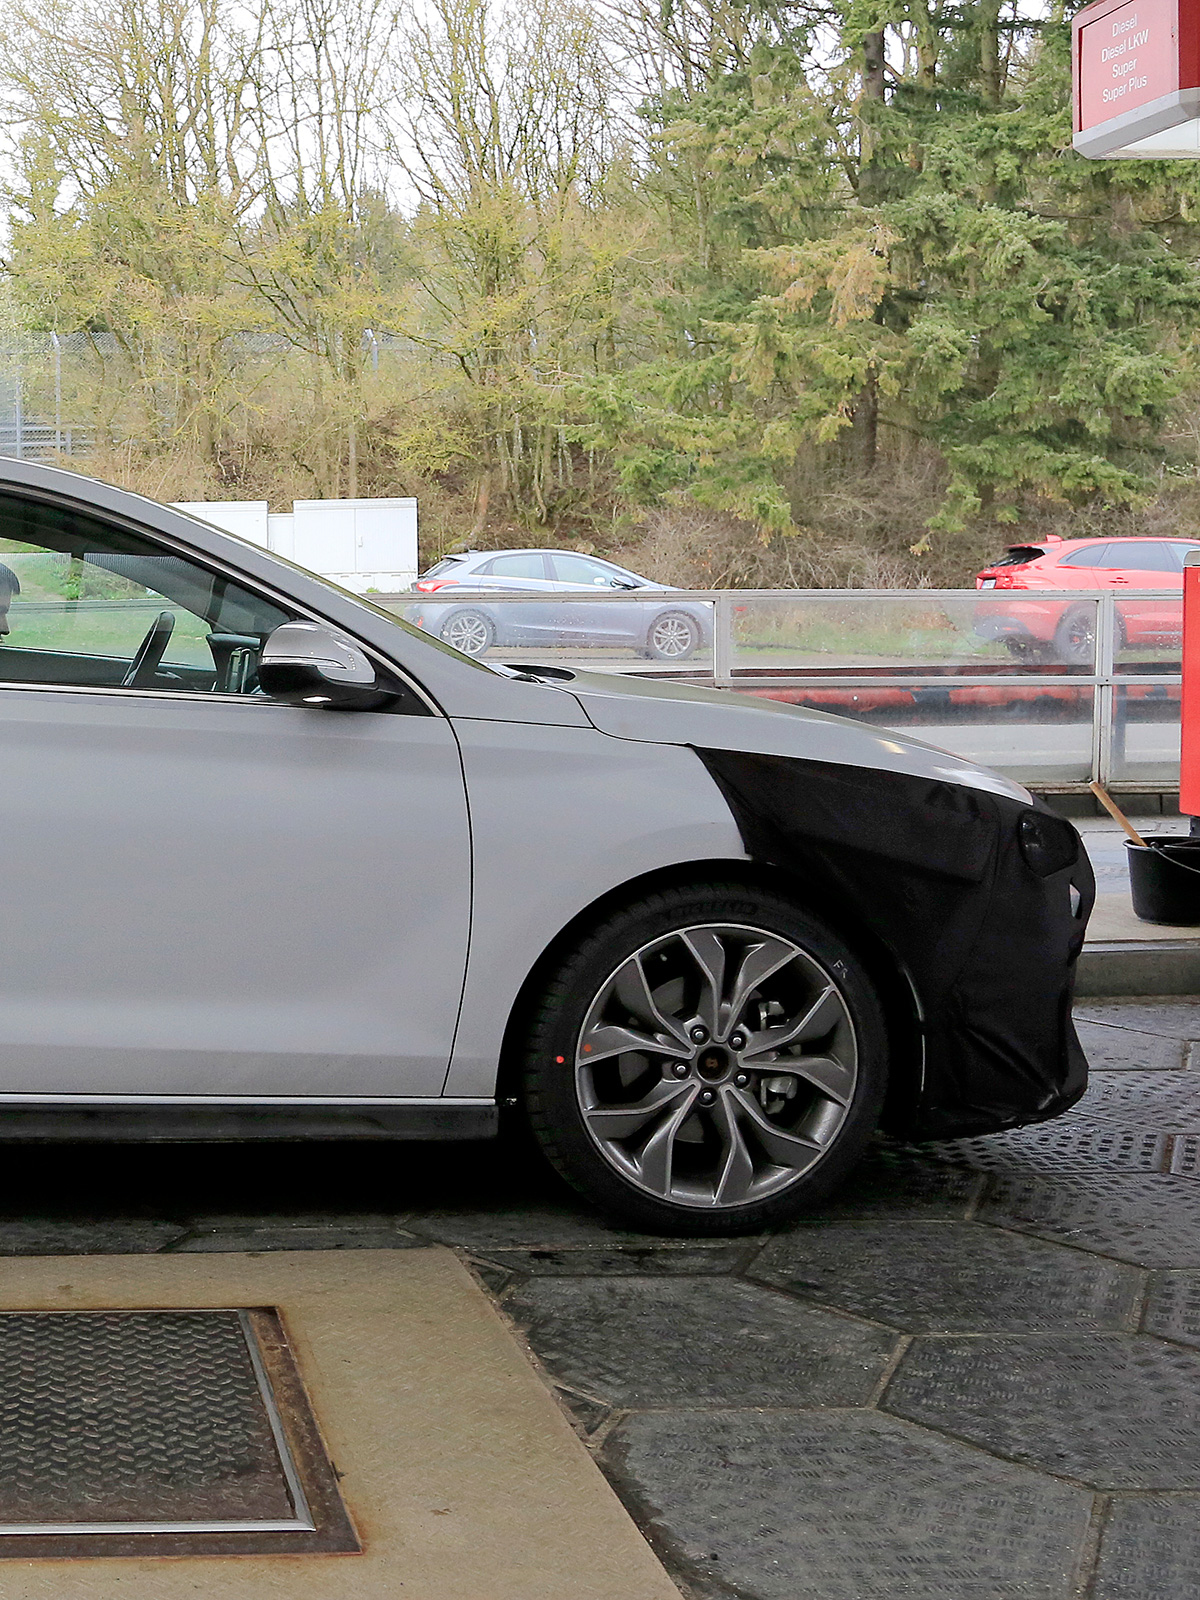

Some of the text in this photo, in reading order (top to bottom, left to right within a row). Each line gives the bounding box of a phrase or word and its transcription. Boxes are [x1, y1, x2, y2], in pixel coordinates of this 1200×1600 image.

[1112, 14, 1138, 37] Diesel
[1101, 28, 1149, 62] Diesel LKW
[1112, 58, 1137, 78] Super
[1102, 75, 1148, 102] Super Plus
